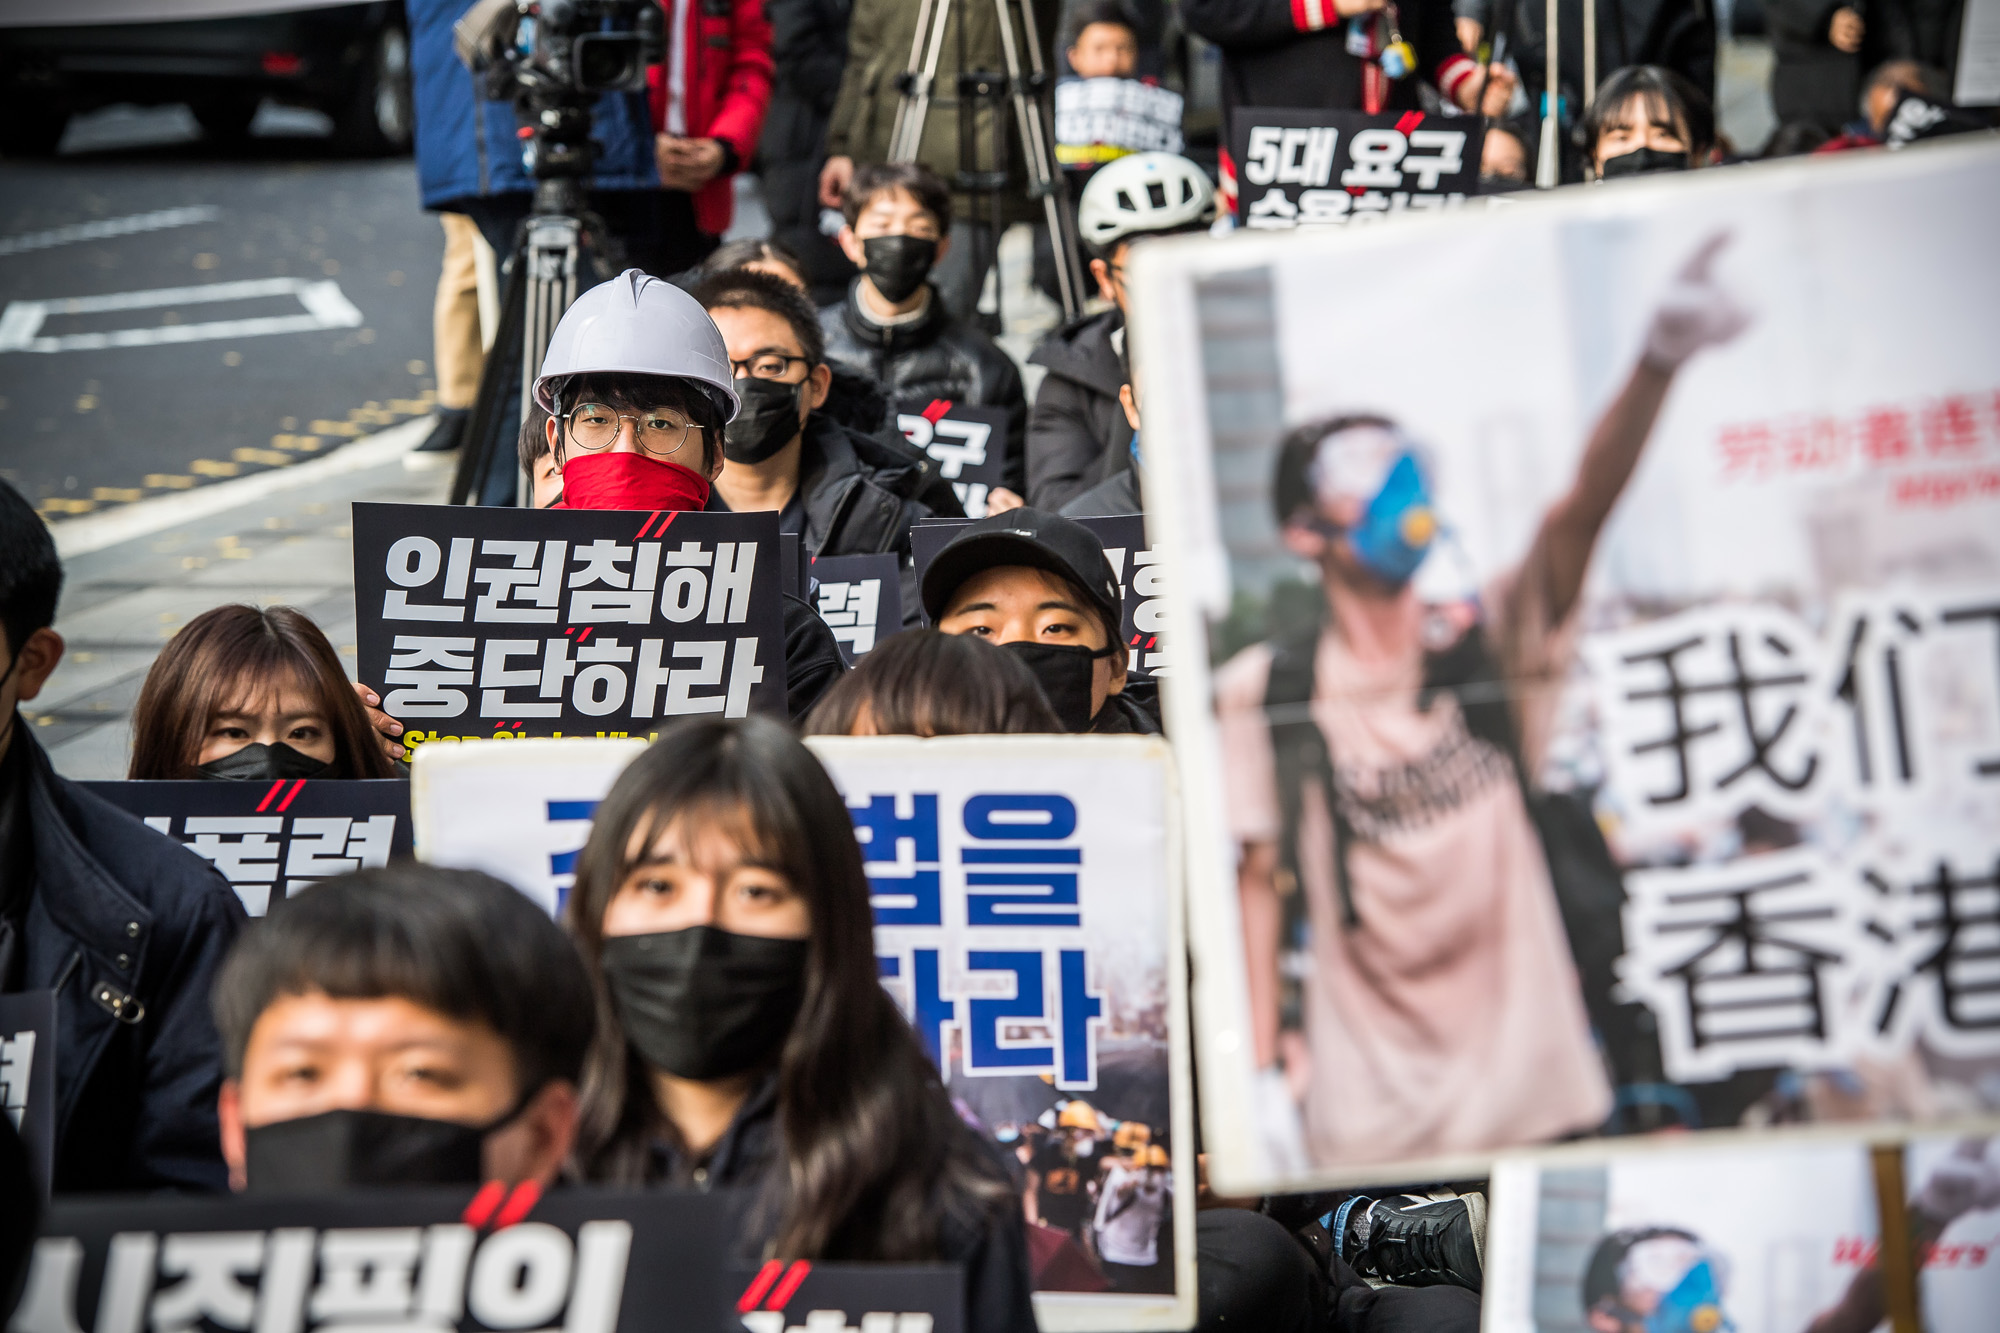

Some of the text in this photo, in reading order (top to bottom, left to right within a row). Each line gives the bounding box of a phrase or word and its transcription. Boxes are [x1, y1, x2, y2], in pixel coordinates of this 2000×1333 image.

[1245, 126, 1468, 190] 5대 요구
[382, 536, 758, 624] 인권침해
[382, 636, 764, 718] 중단하라
